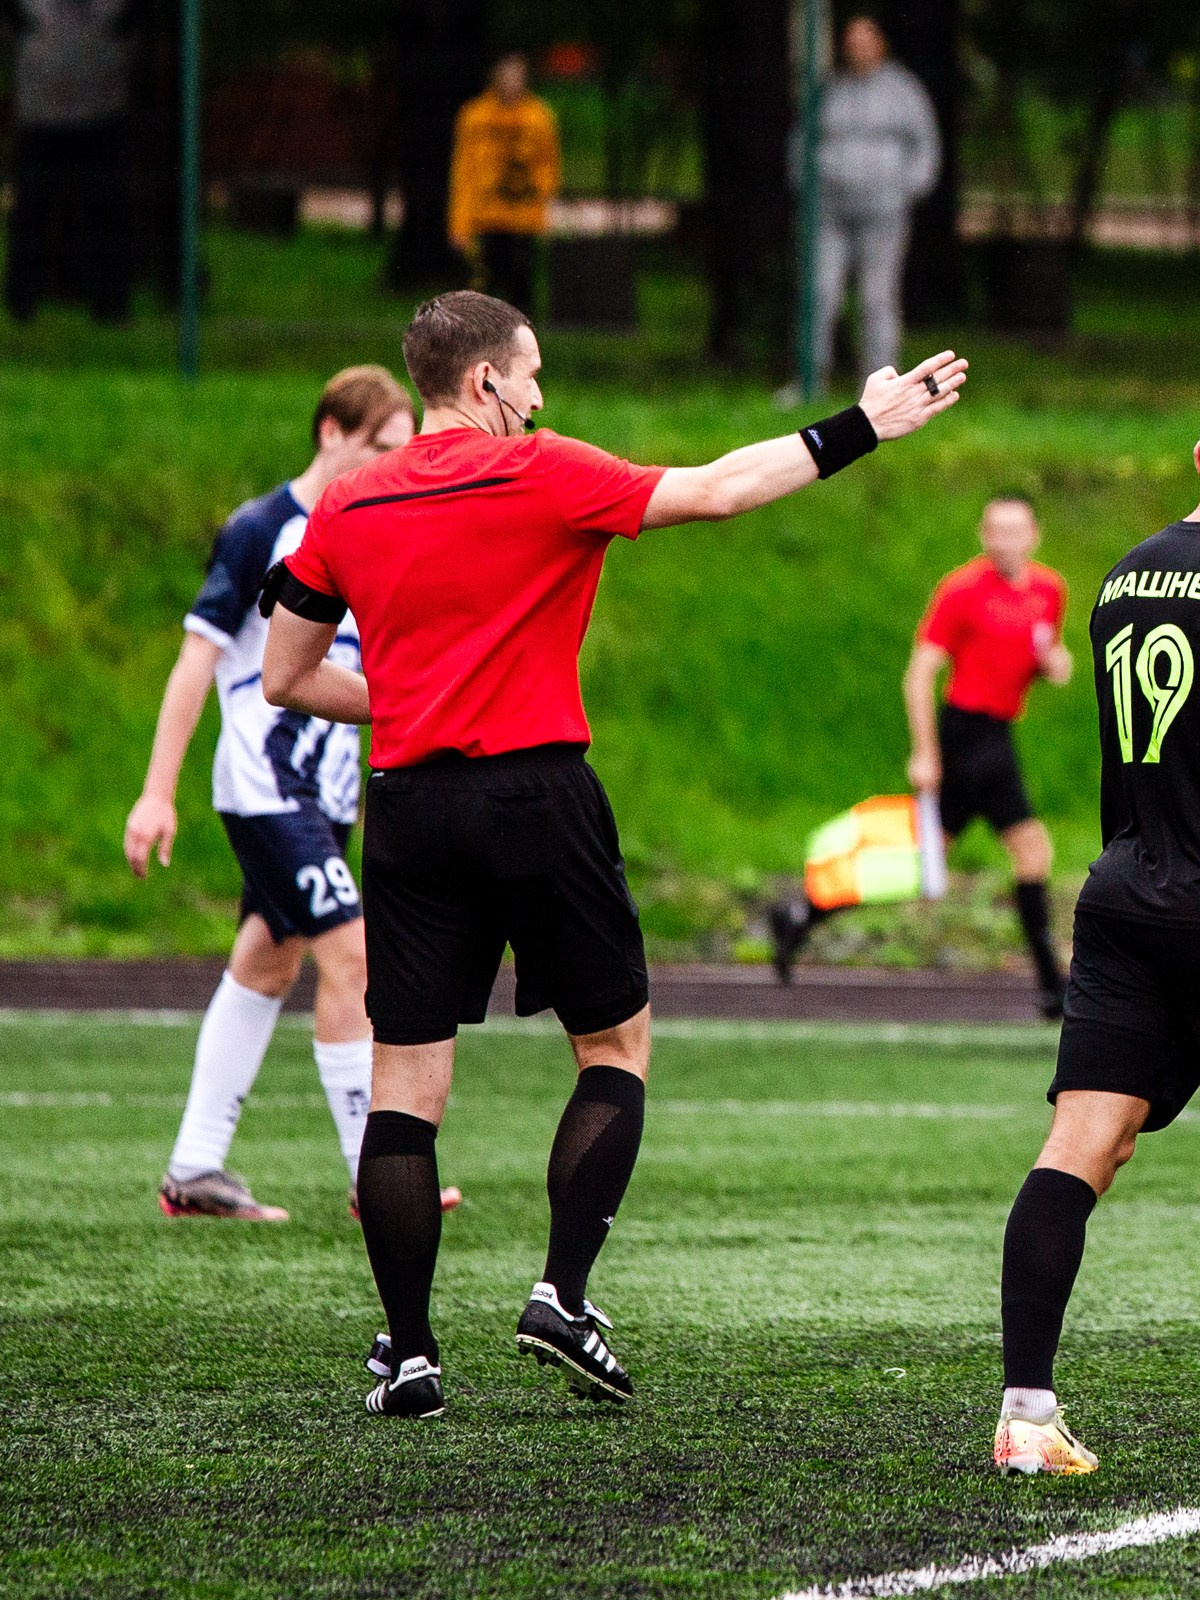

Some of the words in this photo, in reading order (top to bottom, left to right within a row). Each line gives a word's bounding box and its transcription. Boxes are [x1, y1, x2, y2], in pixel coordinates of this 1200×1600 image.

[1105, 622, 1195, 764] 19
[296, 856, 360, 918] 29
[402, 1363, 428, 1377] adidas
